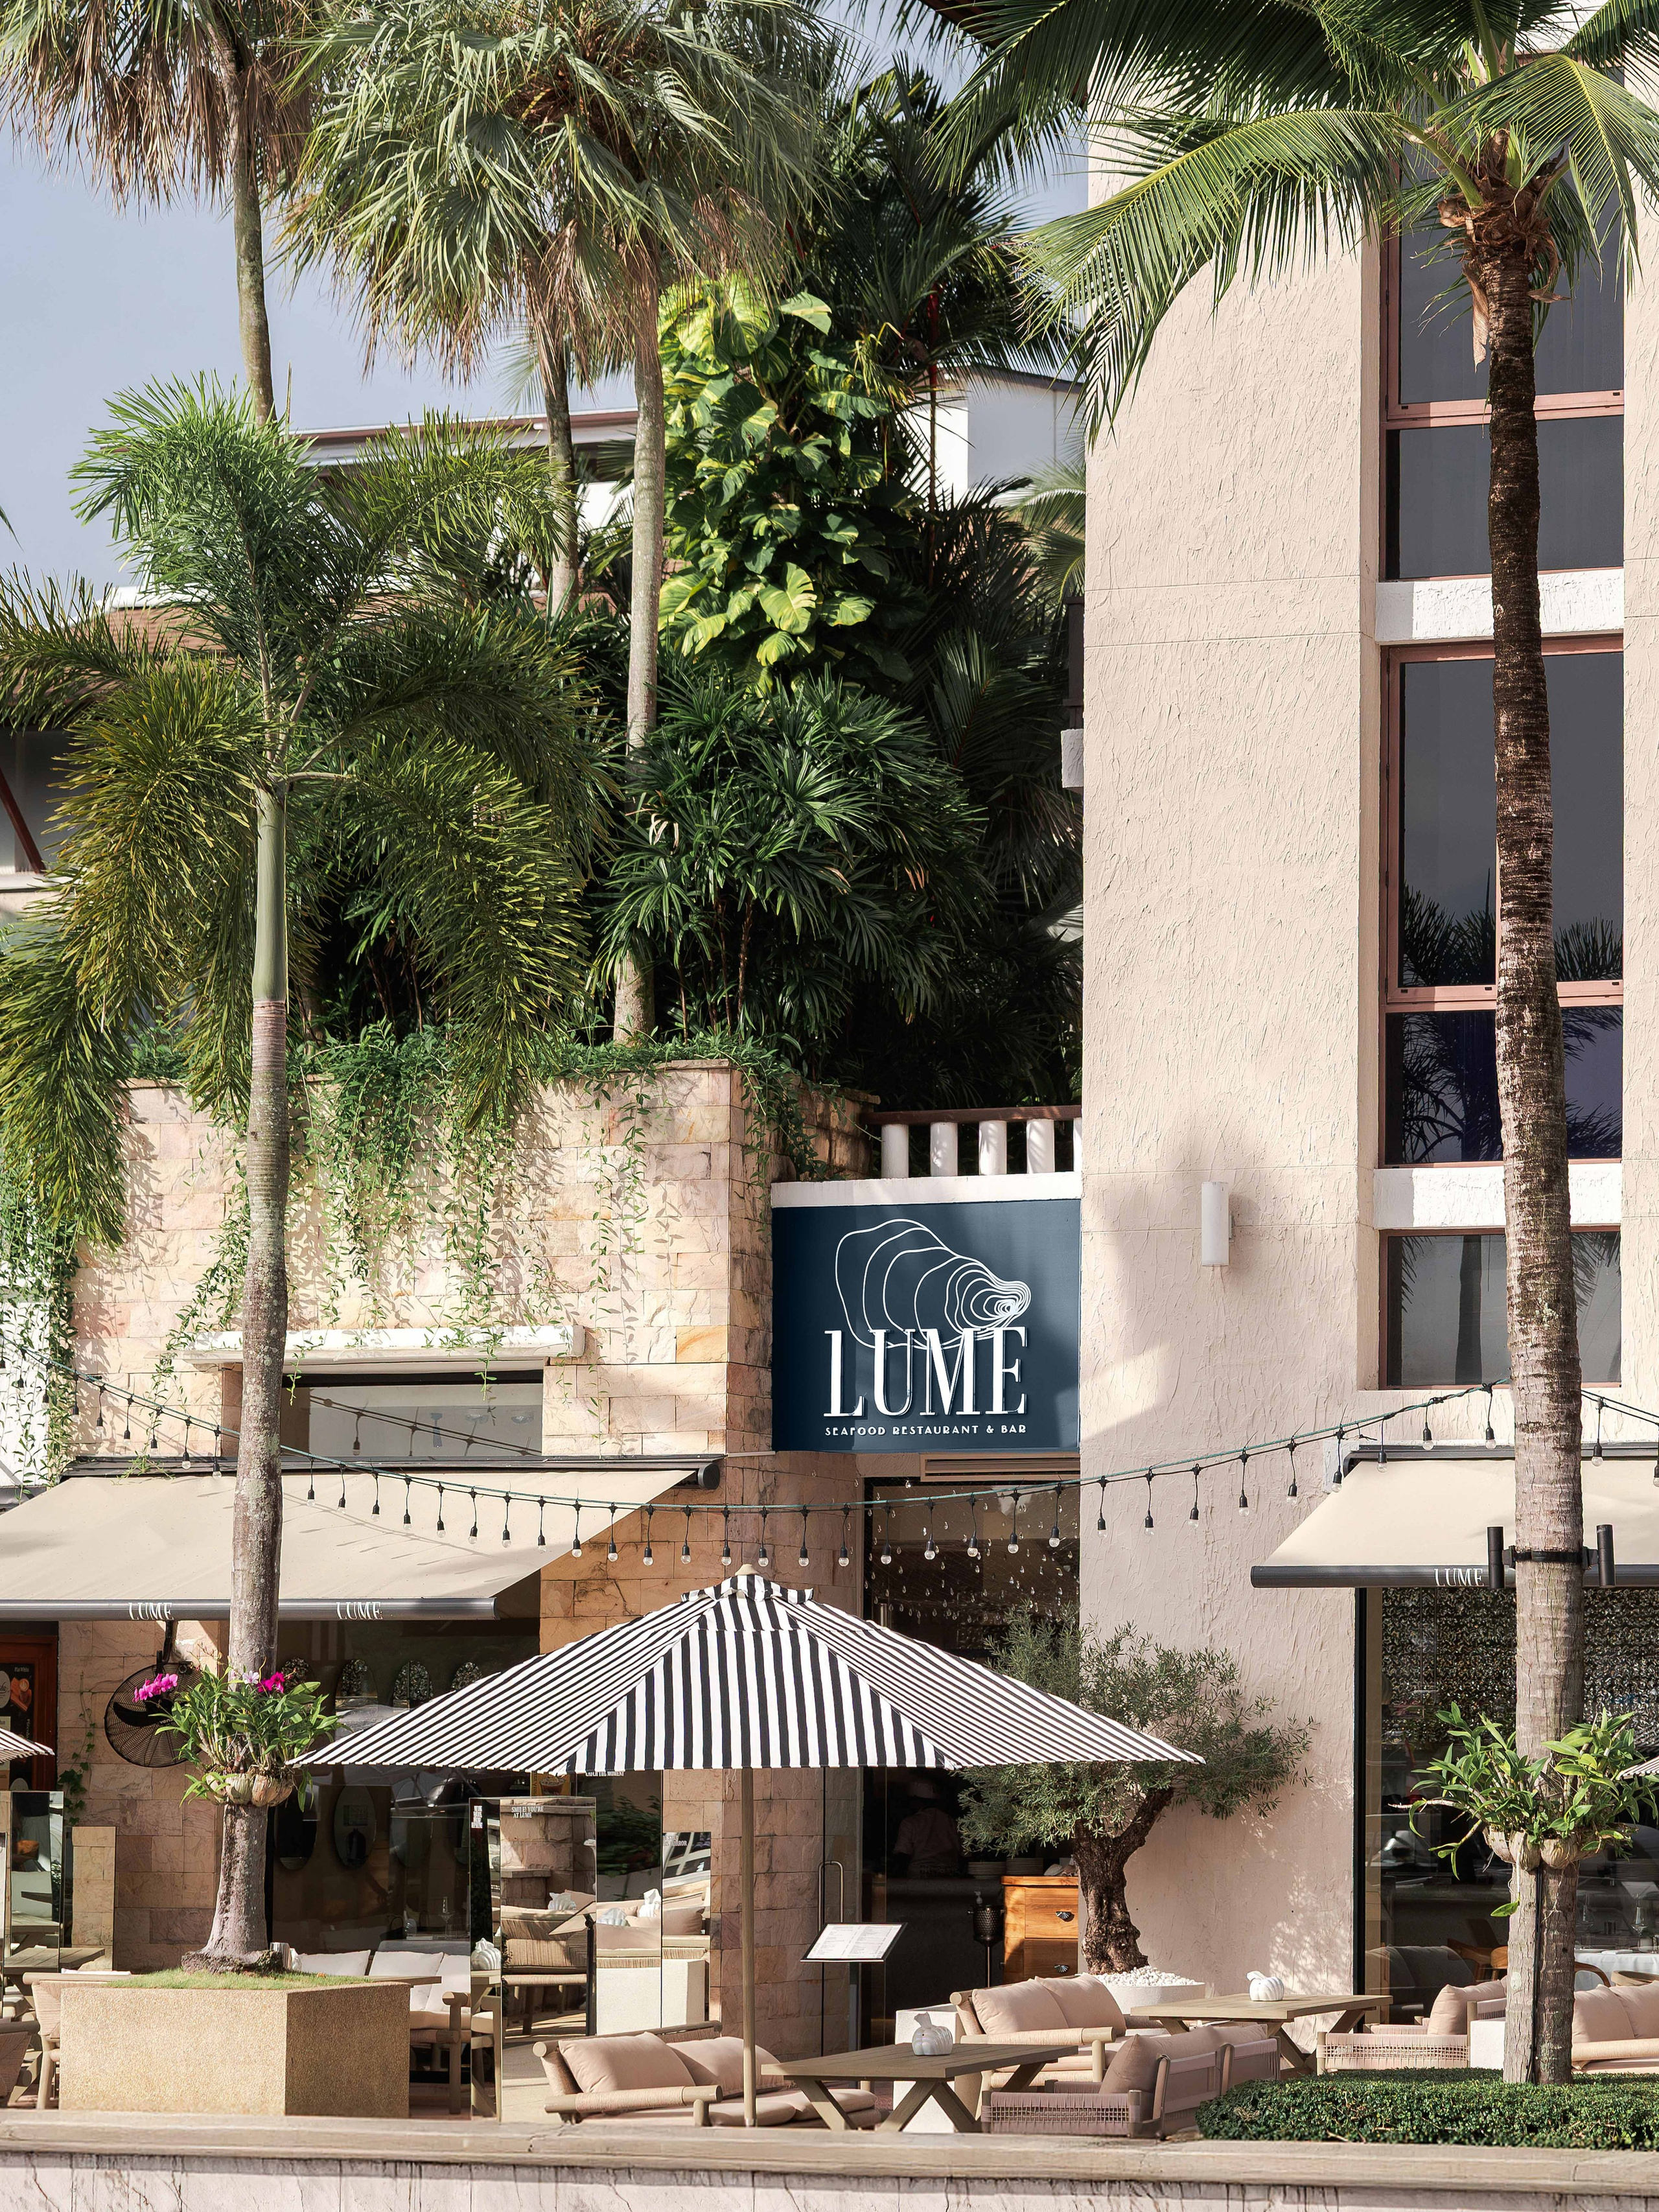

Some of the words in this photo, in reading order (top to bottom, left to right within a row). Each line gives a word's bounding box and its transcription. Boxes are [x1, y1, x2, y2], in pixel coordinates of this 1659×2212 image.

[824, 1327, 1027, 1417] LUME
[825, 1426, 885, 1436] SEAFOOD
[892, 1425, 979, 1435] RESTAURANT
[986, 1425, 994, 1434] &
[1001, 1425, 1026, 1434] BAR
[1433, 1568, 1485, 1587] LUME
[128, 1602, 174, 1620] LUME
[336, 1601, 383, 1620] LUME
